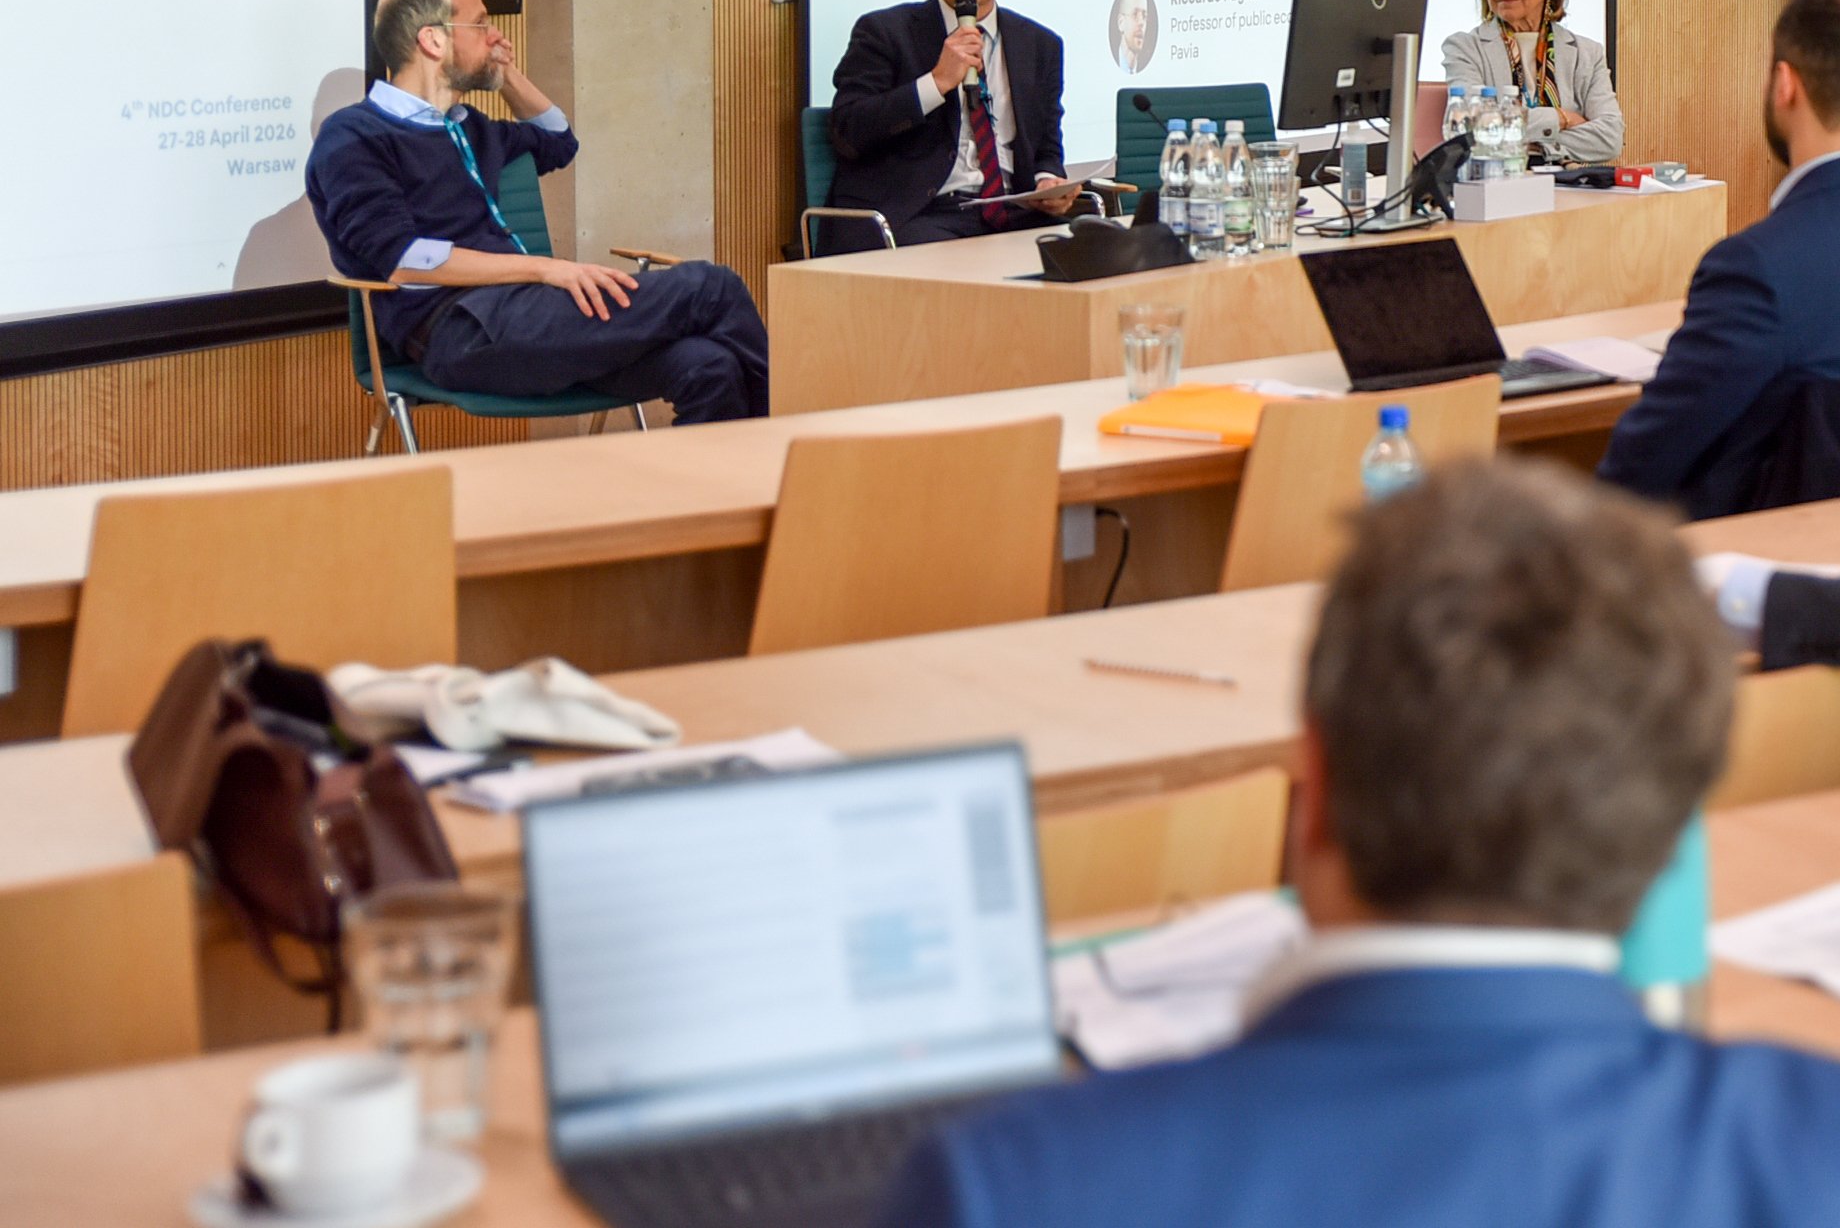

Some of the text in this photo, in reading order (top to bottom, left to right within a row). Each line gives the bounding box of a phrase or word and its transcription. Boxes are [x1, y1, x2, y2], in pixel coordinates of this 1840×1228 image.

[1171, 16, 1222, 33] Professor
[1225, 14, 1237, 29] of
[1239, 11, 1271, 31] public
[1171, 44, 1199, 60] Pavia
[121, 95, 292, 120] 4th NDC Conference
[158, 124, 296, 150] 27-28 April 2026
[226, 159, 296, 176] Warsaw
